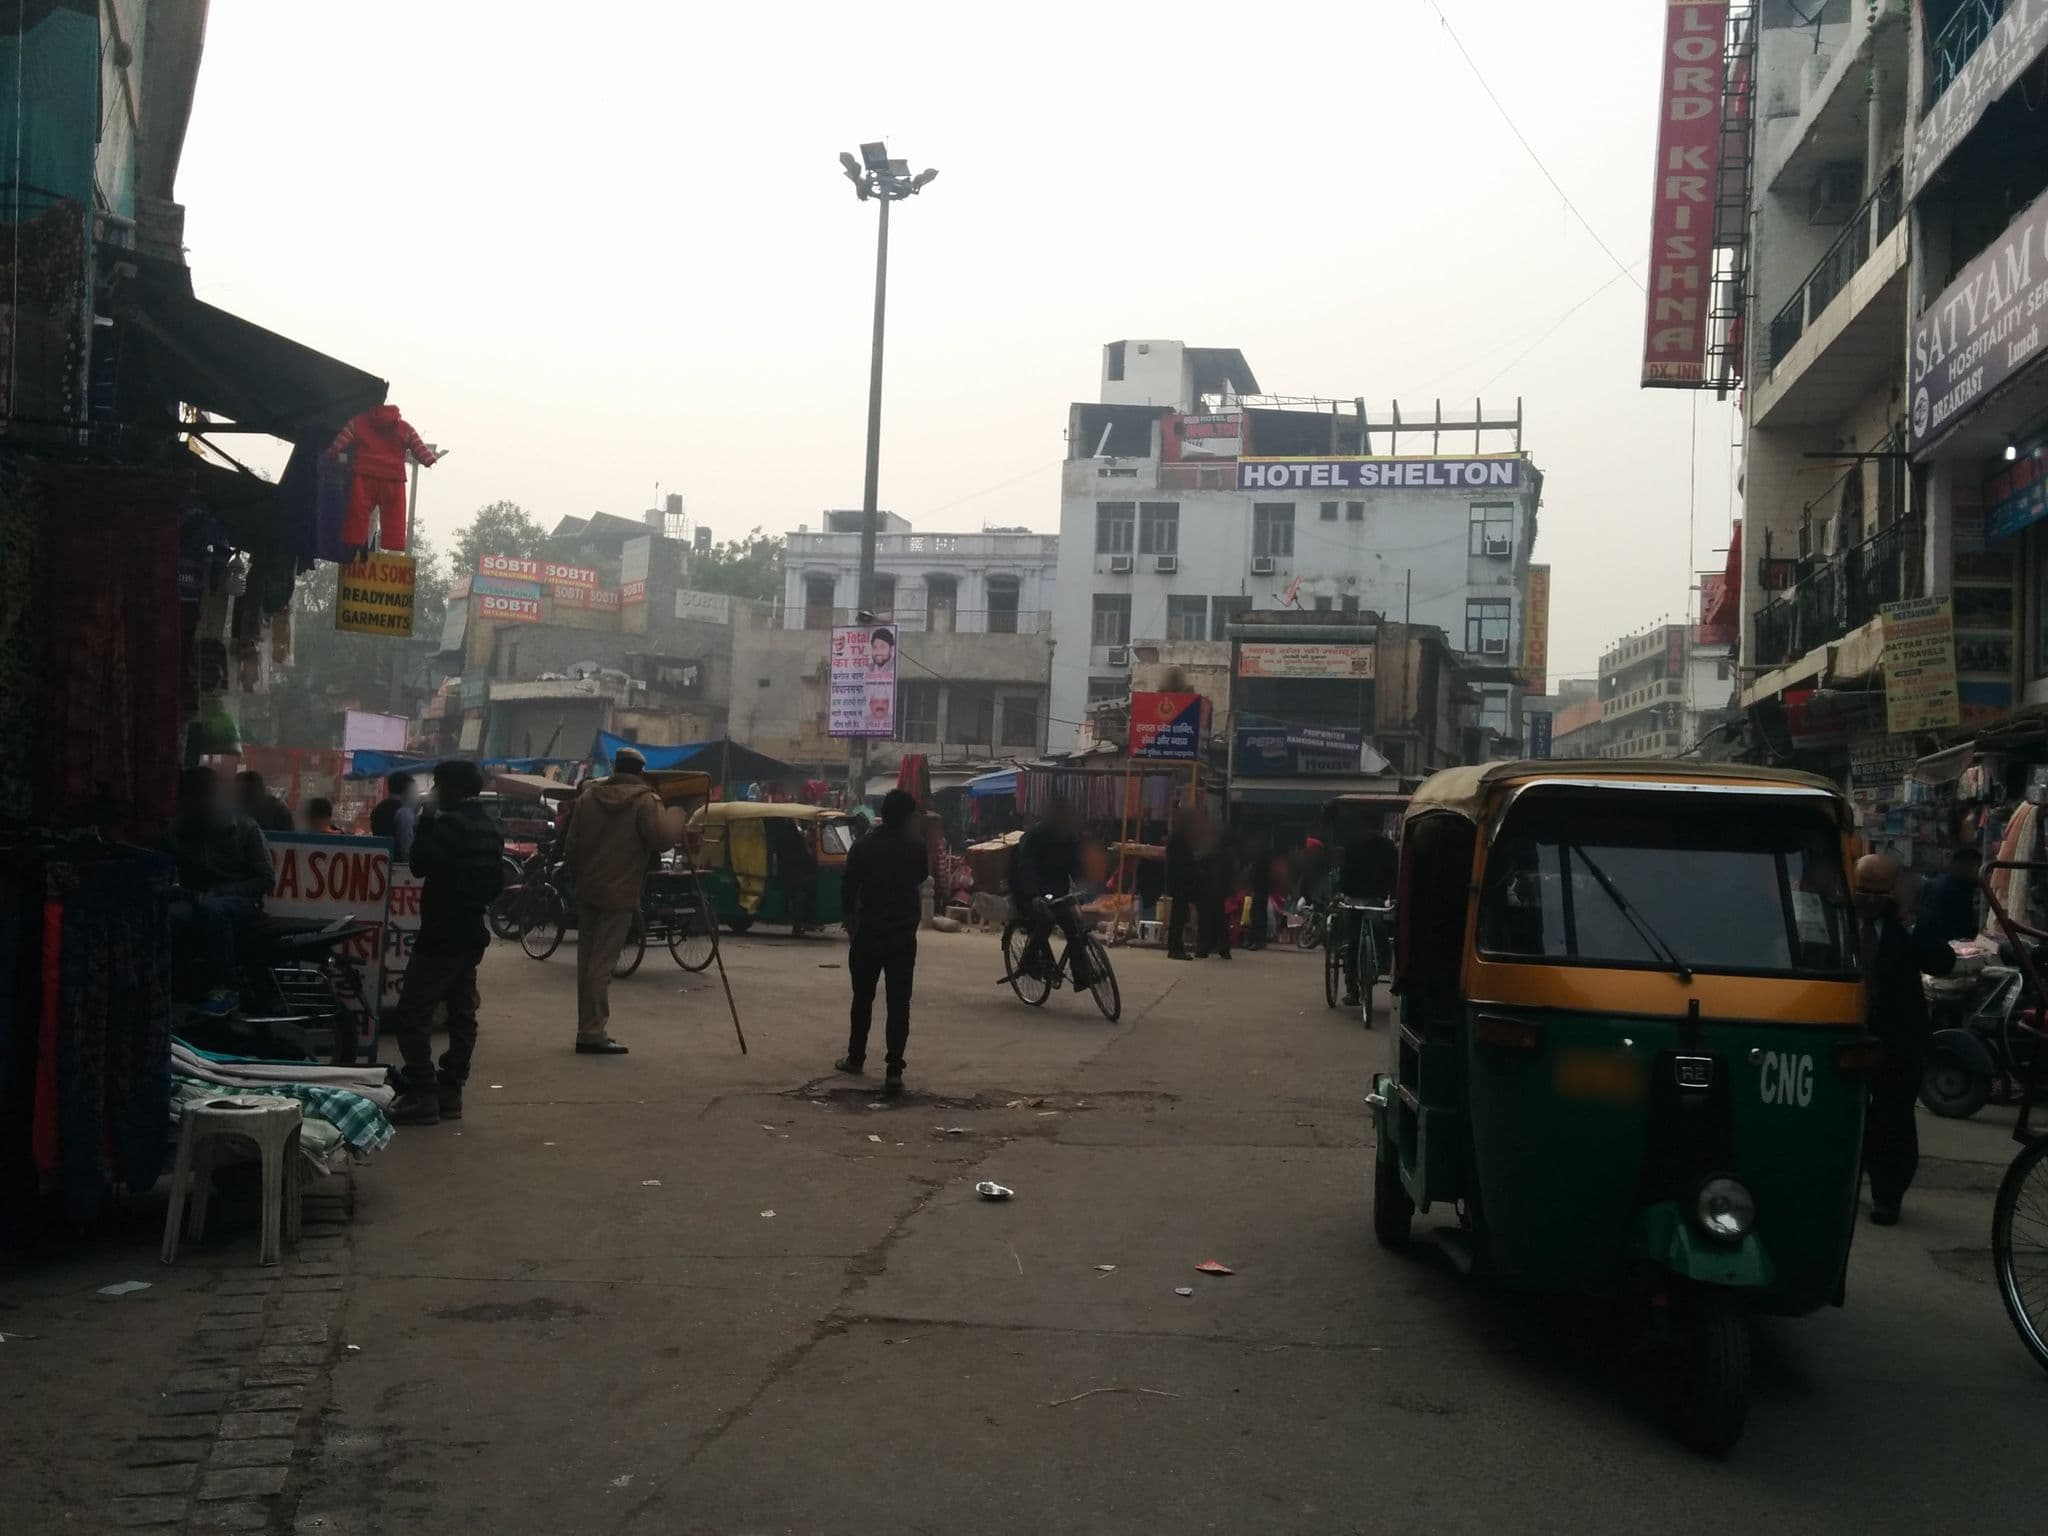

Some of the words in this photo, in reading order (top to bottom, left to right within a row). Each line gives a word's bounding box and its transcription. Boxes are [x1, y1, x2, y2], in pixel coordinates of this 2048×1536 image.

[1670, 7, 1717, 121] LORD
[1653, 145, 1709, 352] KRISHNA
[1915, 224, 2034, 385] SATYAM
[1948, 302, 2023, 385] HOSPITALITY
[1931, 366, 1984, 429] BREAKFAST
[2007, 323, 2039, 368] Lunch
[1200, 415, 1226, 423] HOTEL
[1244, 463, 1349, 487] HOTEL
[1360, 462, 1513, 486] SHELTON
[484, 557, 537, 574] SOBTI
[545, 565, 595, 582] SOBTI
[380, 564, 416, 586] SONS
[342, 587, 415, 608] READYMADE
[555, 586, 584, 600] SOBTI
[590, 590, 618, 603] SOBTI
[624, 582, 645, 597] SOBTI
[485, 596, 538, 614] SOBTI
[342, 611, 410, 629] GARMENTS
[1529, 574, 1545, 666] SHELTON
[846, 632, 870, 644] Total
[1884, 638, 1923, 652] SATYAM
[850, 646, 866, 654] TV
[1903, 647, 1945, 659] TRAVELS
[306, 851, 390, 901] SONS
[1760, 1050, 1814, 1108] CNG
